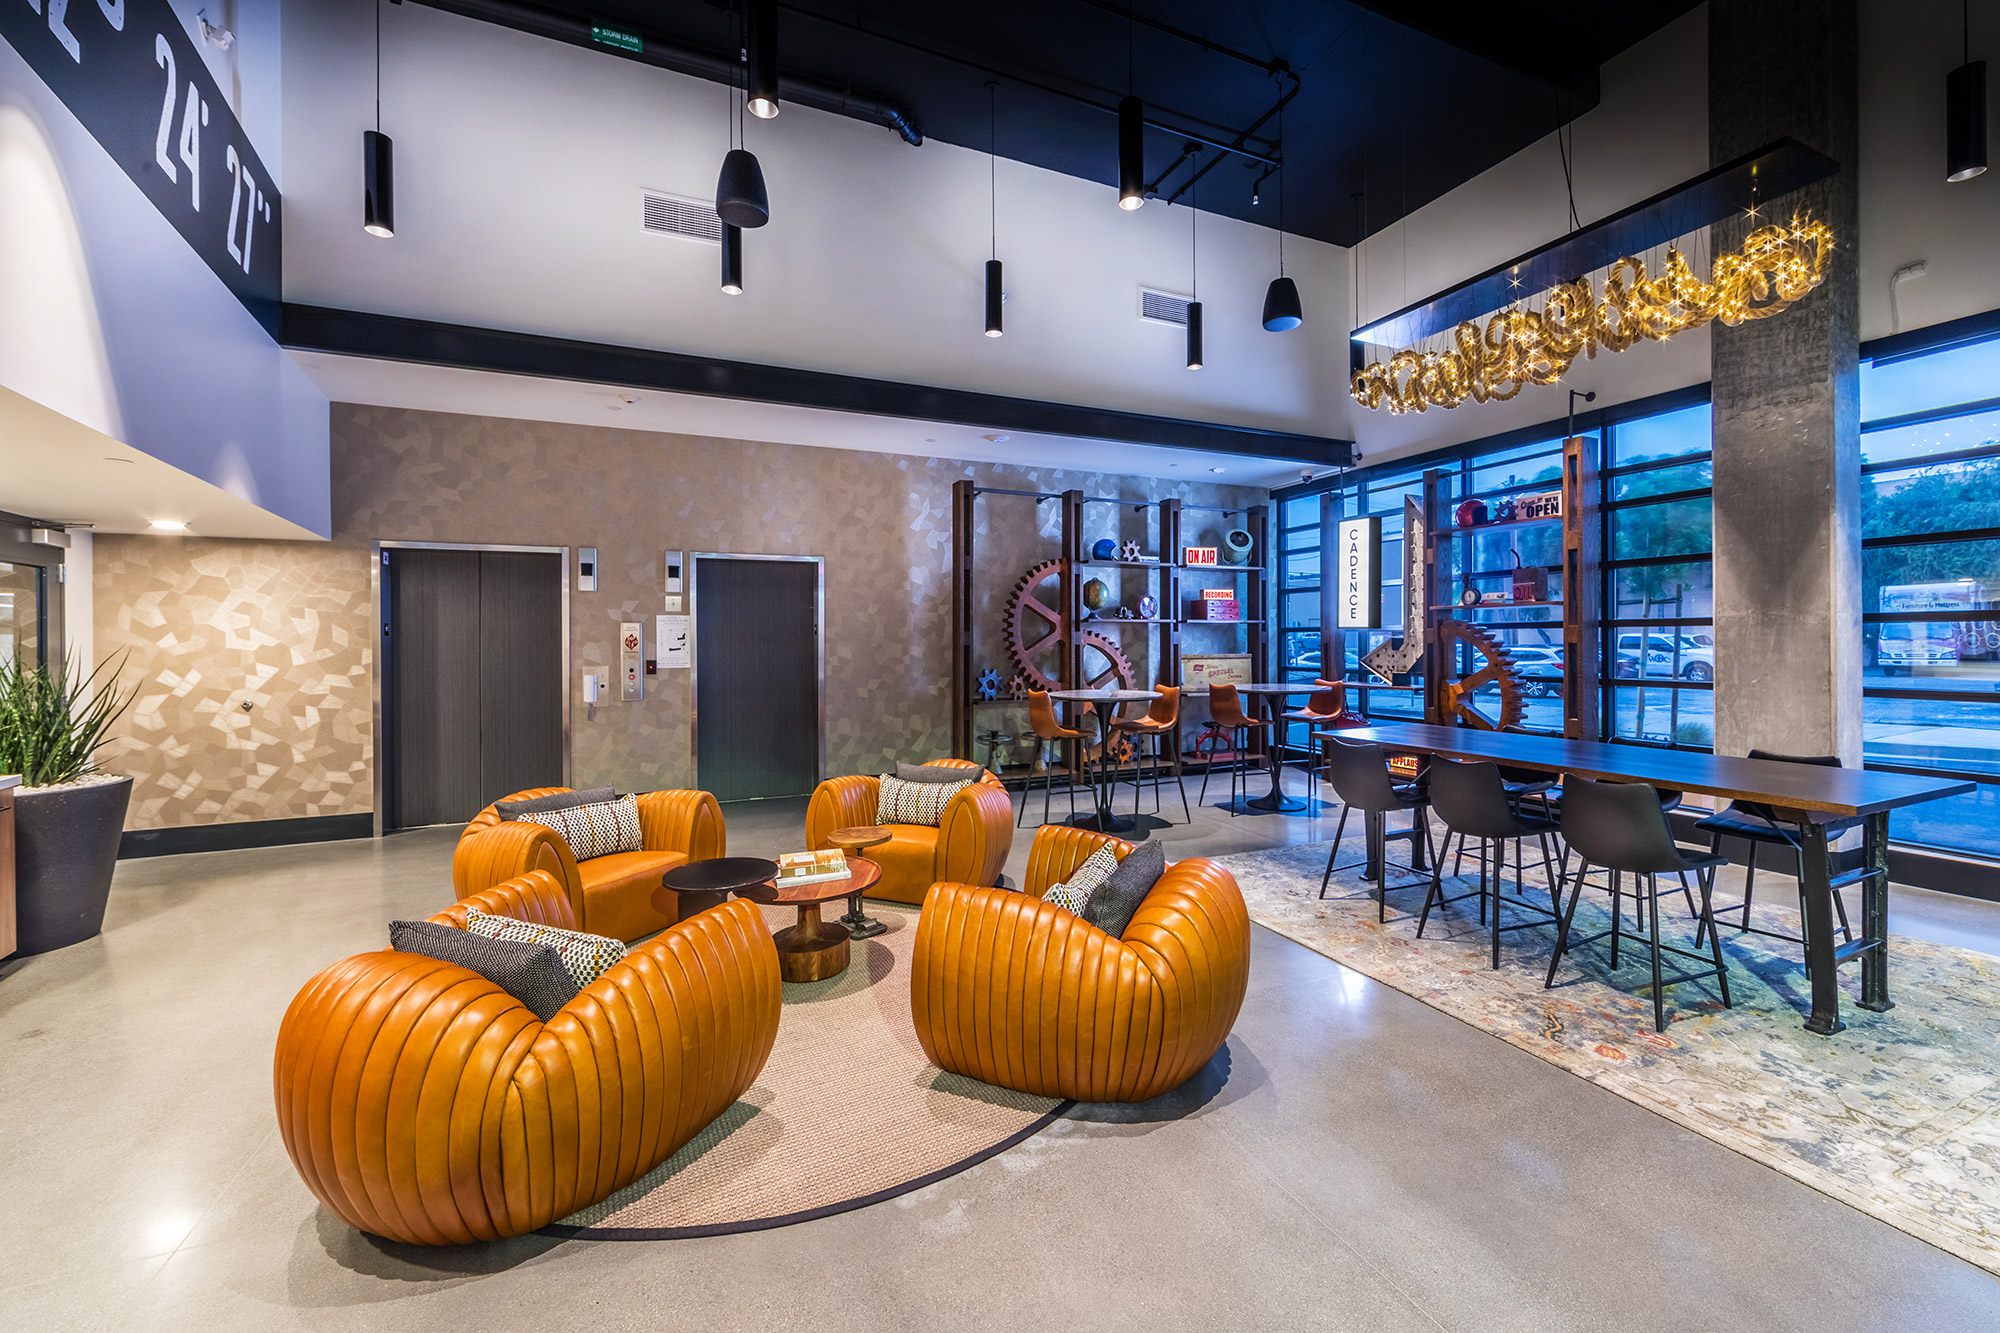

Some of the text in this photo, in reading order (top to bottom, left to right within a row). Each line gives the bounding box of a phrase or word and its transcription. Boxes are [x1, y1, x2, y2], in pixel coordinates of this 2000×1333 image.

[602, 28, 639, 44] STORM DRAIN
[1526, 501, 1559, 518] OPEN
[1187, 549, 1216, 564] ON AIR
[1349, 528, 1359, 619] CADENCE
[1204, 591, 1233, 599] RECORDING
[1513, 584, 1535, 601] OIL
[1392, 757, 1418, 769] APPLAUS
